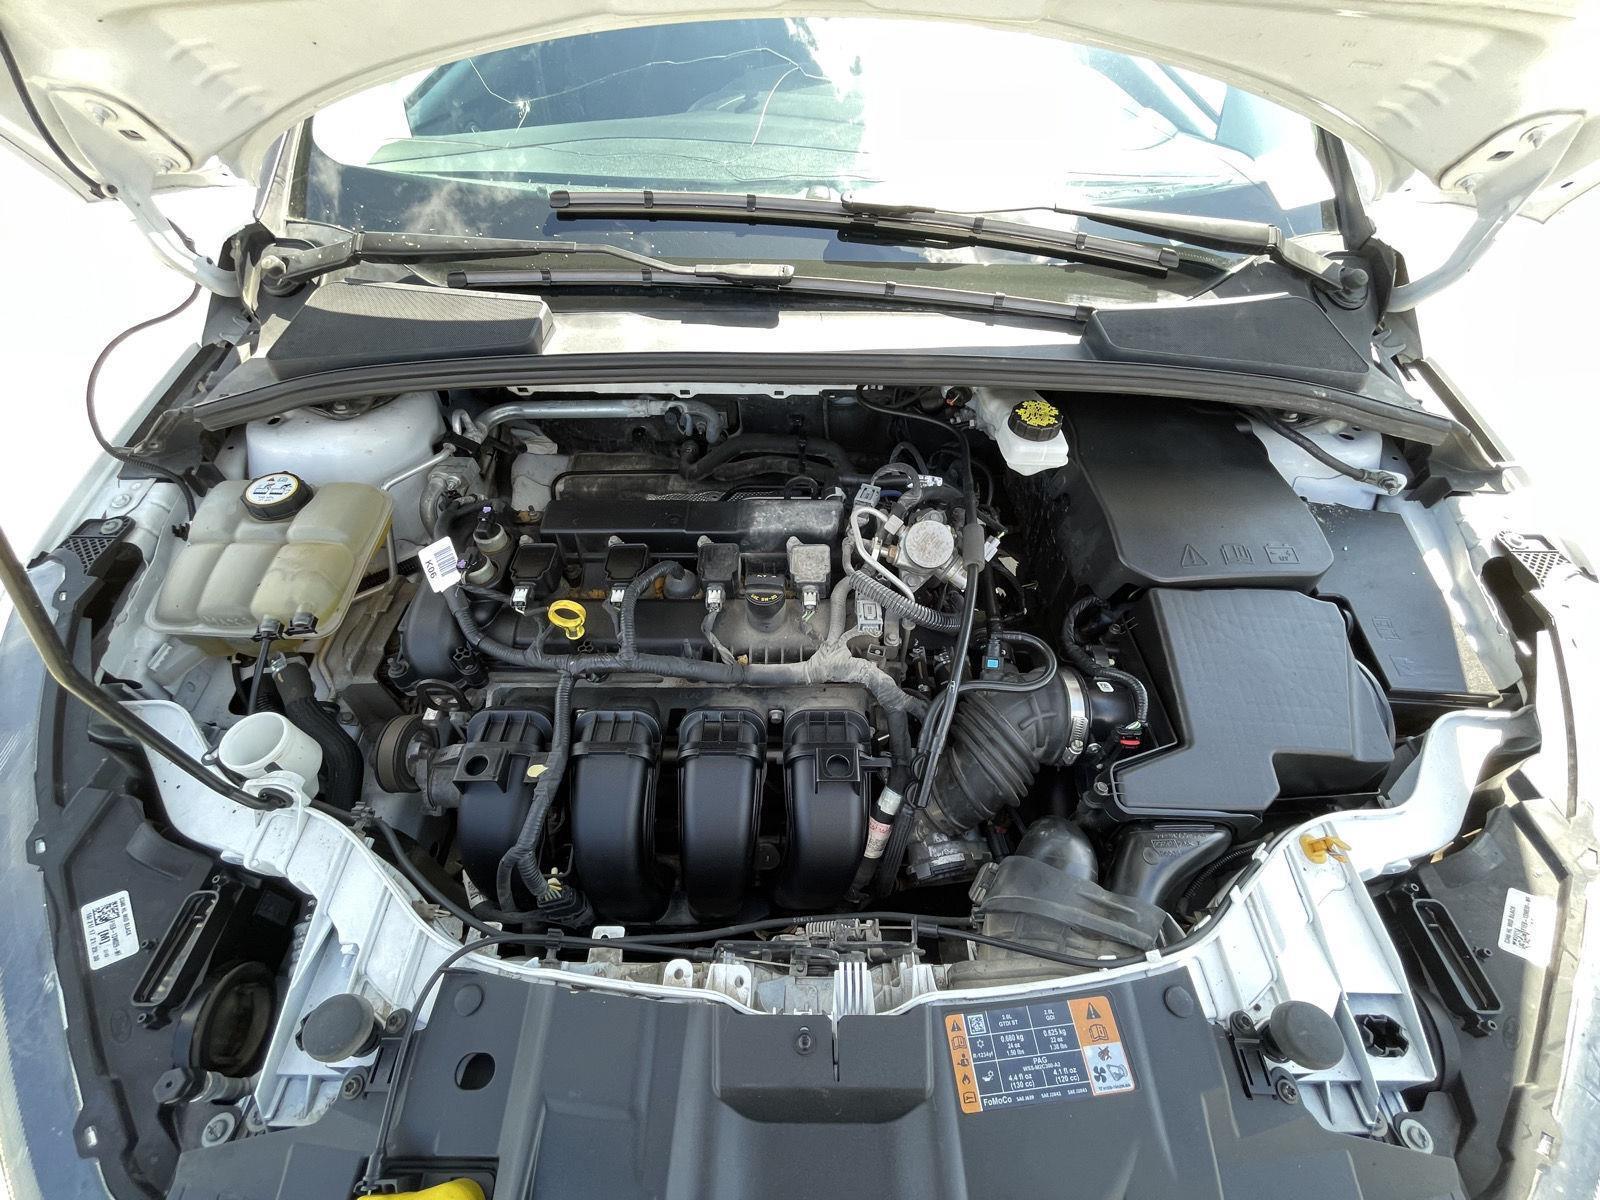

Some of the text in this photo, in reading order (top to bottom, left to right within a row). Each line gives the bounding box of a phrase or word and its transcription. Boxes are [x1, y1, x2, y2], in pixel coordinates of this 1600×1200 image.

[425, 559, 437, 579] K06
[973, 1051, 994, 1059] R-1234yf
[1053, 1068, 1063, 1076] 4.1
[1056, 1074, 1080, 1084] (120 cc)
[1010, 1080, 1035, 1091] (130 cc)
[984, 1096, 1013, 1107] FoMoCo
